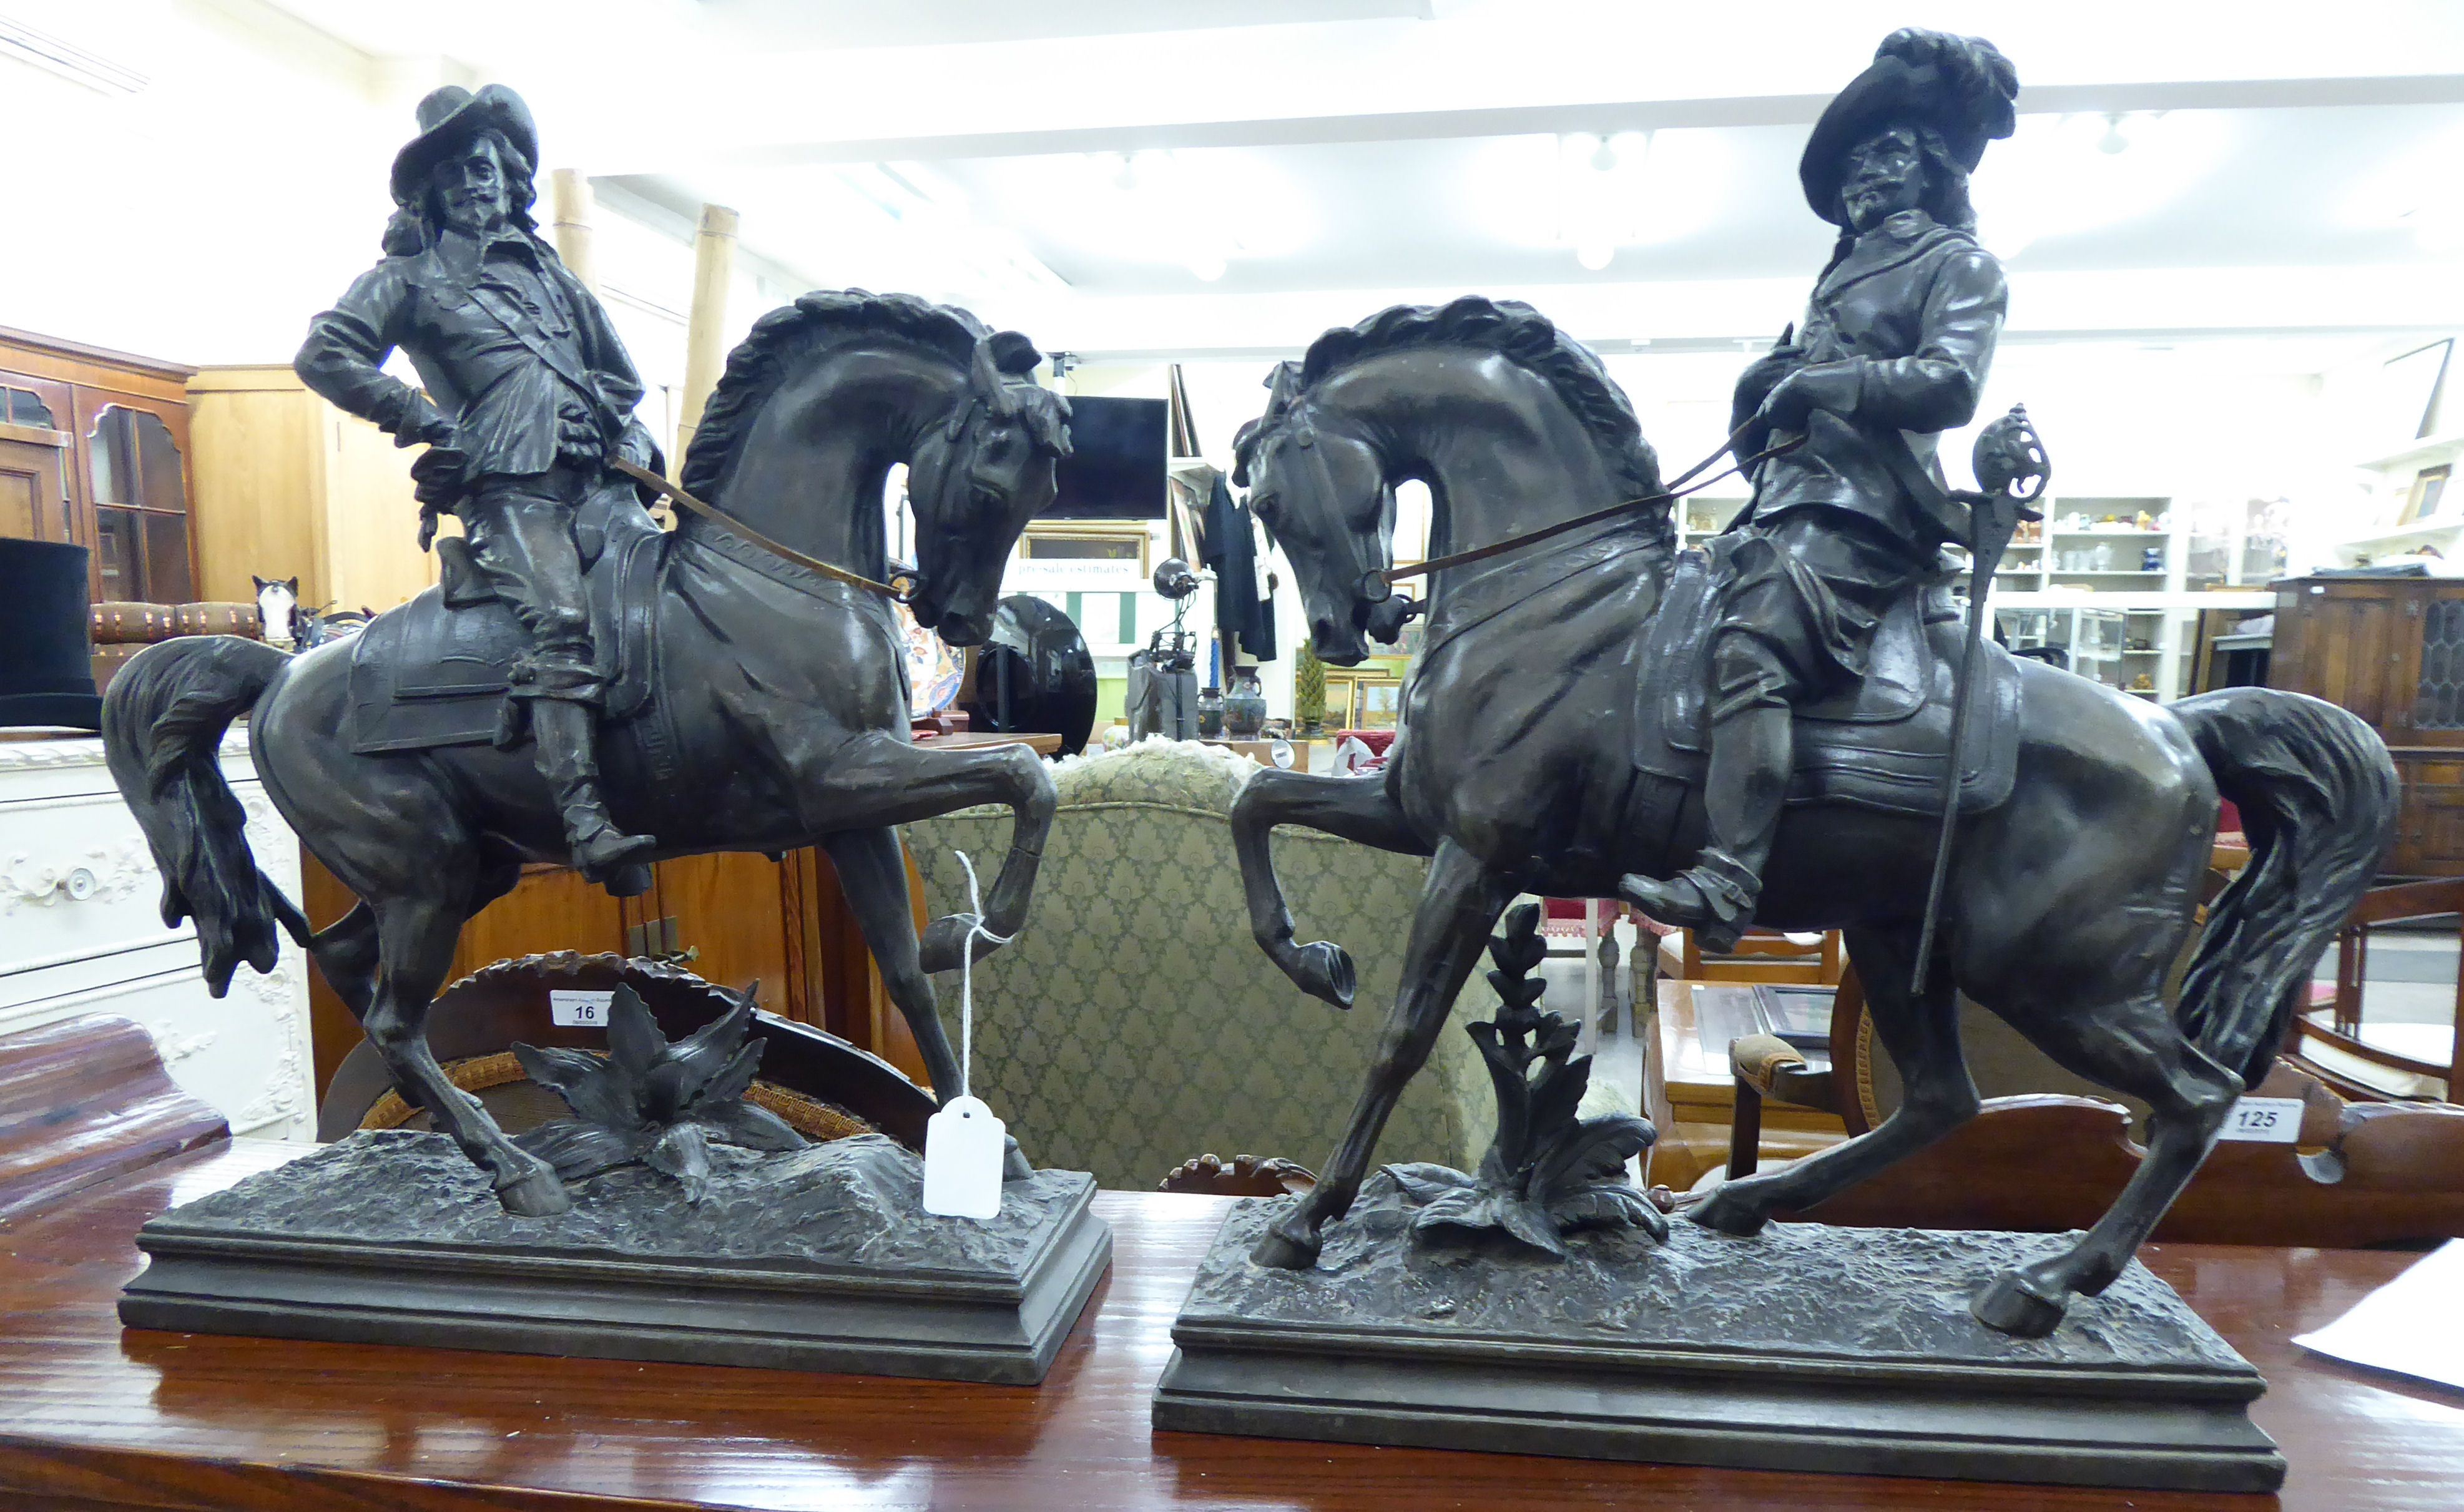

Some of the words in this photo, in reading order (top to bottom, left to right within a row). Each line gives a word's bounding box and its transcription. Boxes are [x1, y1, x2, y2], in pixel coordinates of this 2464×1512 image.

[1018, 563, 1063, 575] pre-sale
[1069, 564, 1129, 574] estimates
[576, 1006, 594, 1019] 16
[2239, 1111, 2278, 1127] 125
